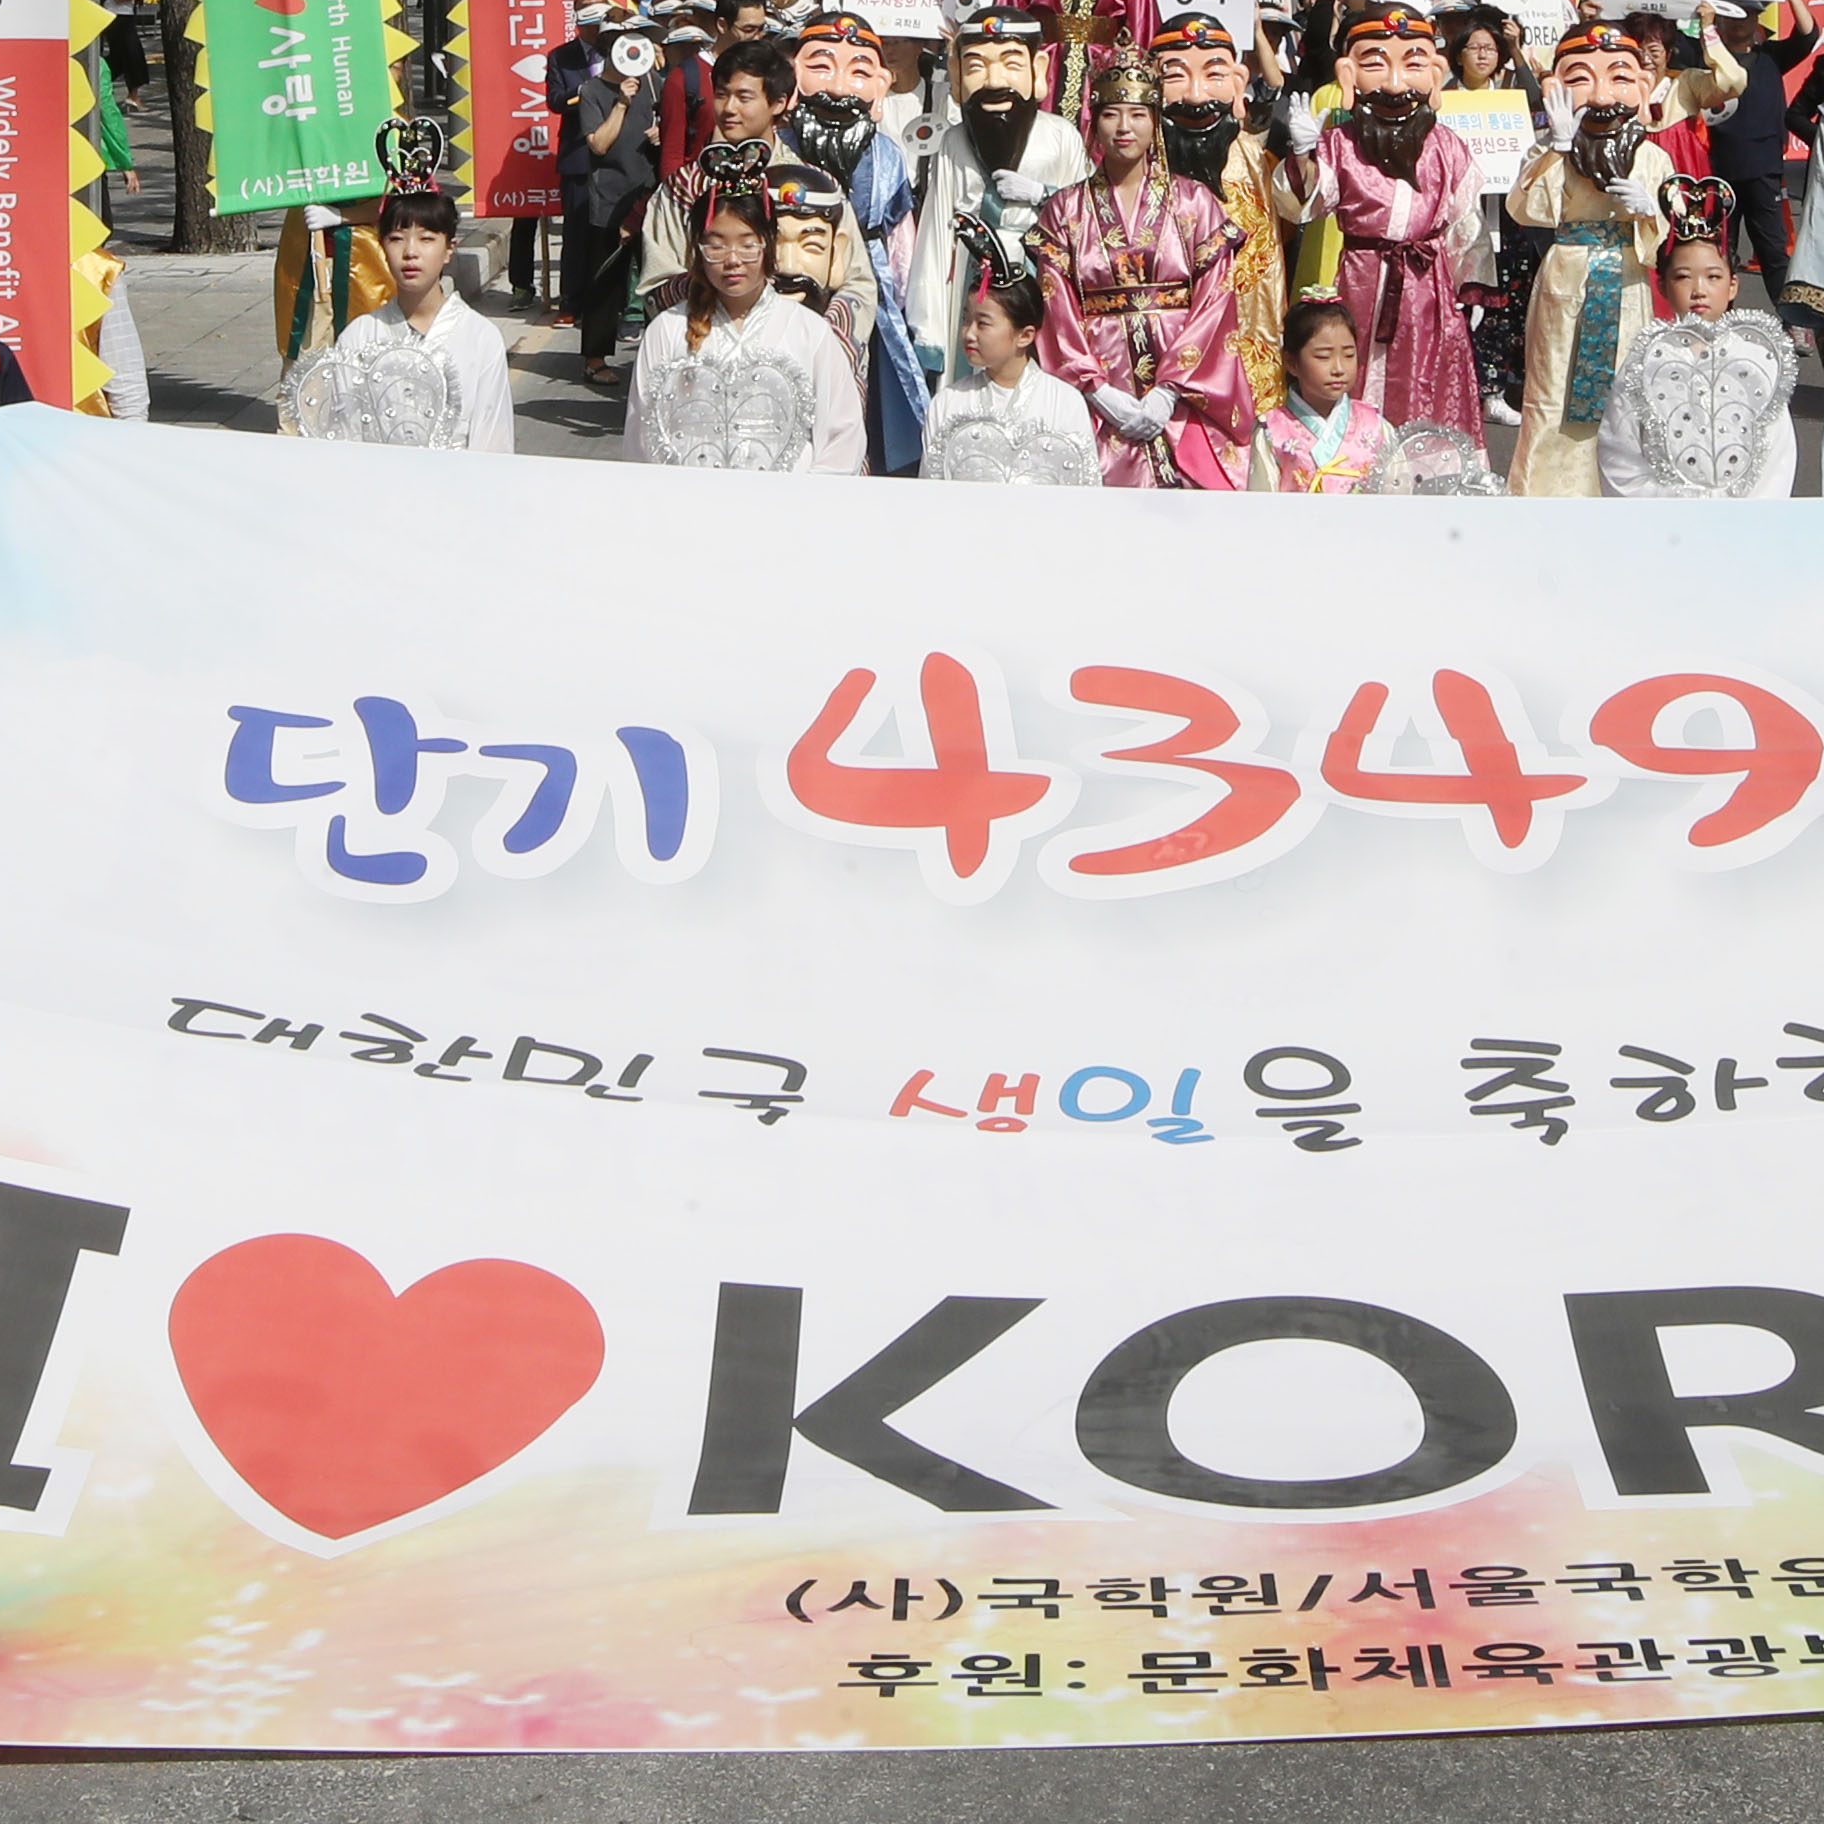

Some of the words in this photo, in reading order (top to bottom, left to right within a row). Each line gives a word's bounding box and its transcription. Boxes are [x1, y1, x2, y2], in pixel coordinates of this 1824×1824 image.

[332, 35, 355, 117] Human
[240, 159, 371, 201] (사)국학원
[226, 693, 696, 888] 단기
[166, 994, 810, 1128] 대한민국
[891, 1045, 1366, 1152] 생일을
[837, 1648, 1088, 1702] 후원:
